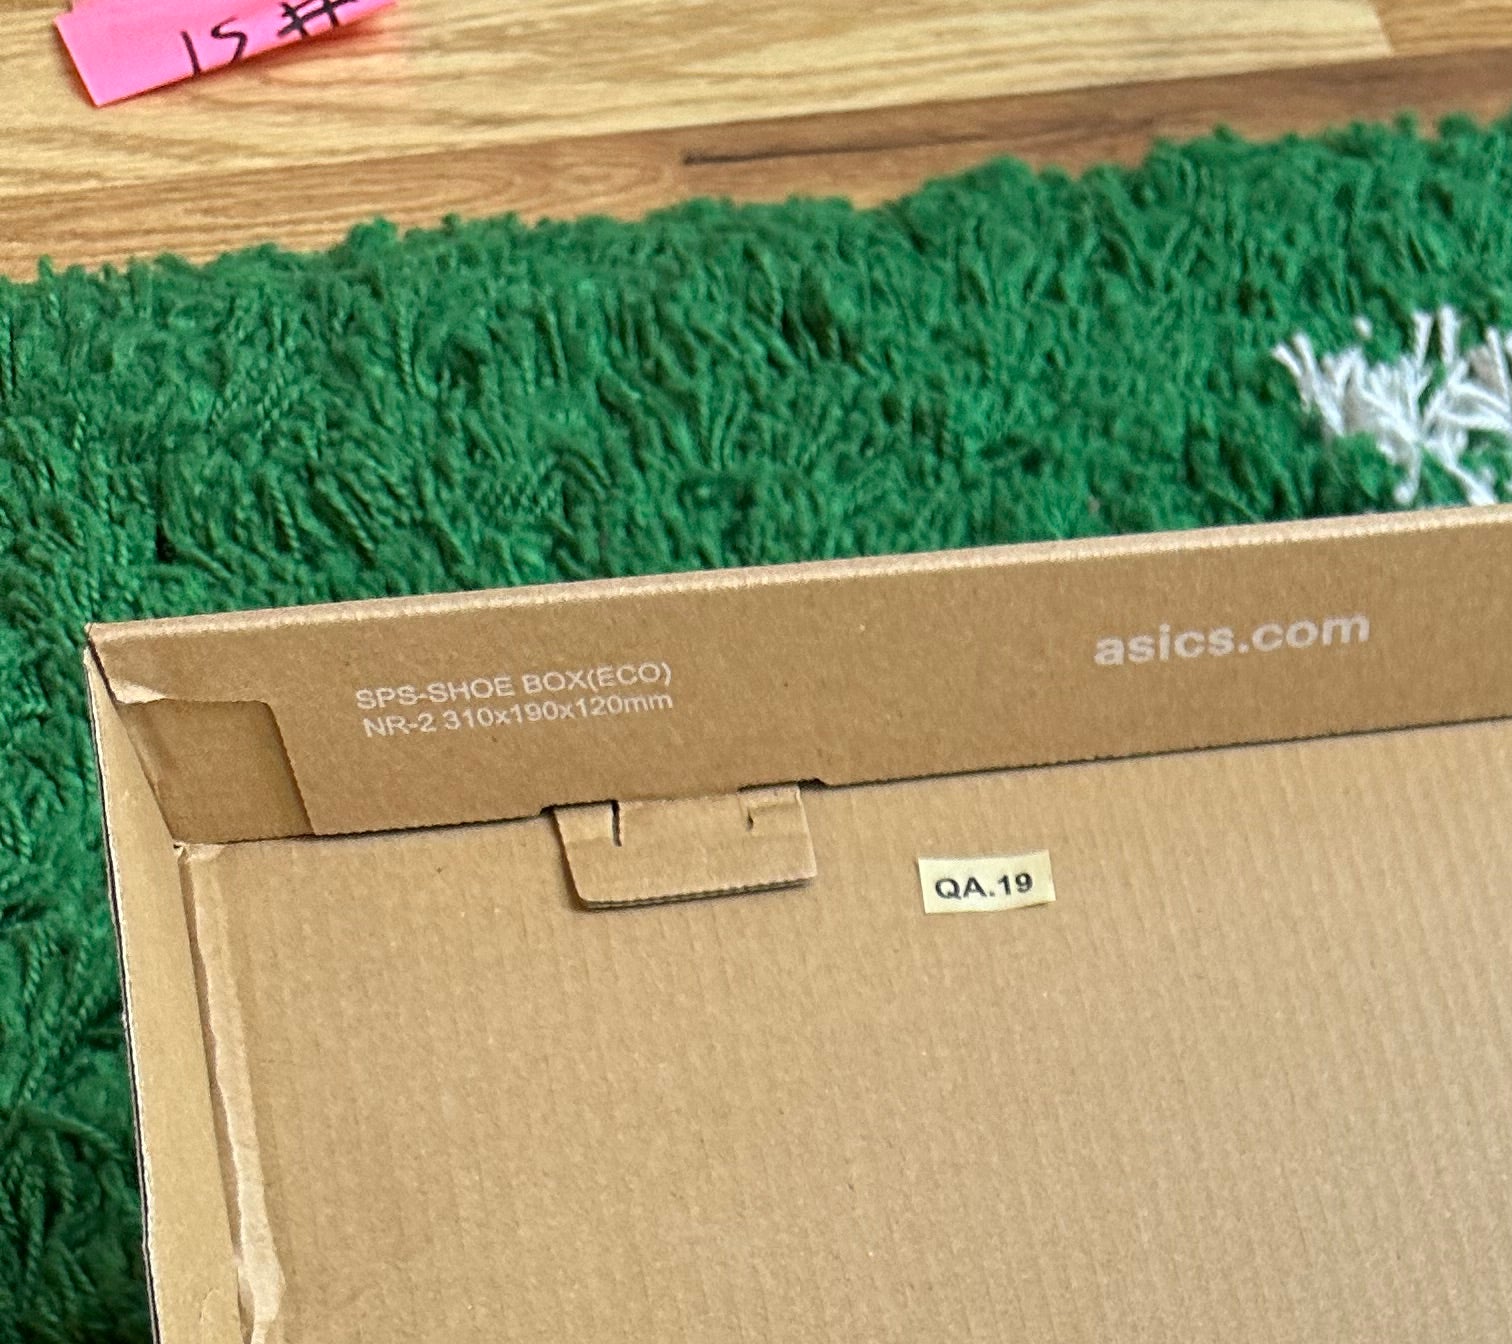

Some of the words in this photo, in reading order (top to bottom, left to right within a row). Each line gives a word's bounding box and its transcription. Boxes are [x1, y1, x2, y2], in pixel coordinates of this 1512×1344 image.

[1094, 612, 1371, 666] asics.com
[355, 676, 515, 709] SPS-SHOE
[521, 661, 672, 695] BOX(ECO)
[363, 712, 437, 738] NR-2
[443, 693, 673, 731] 310x190x120mm
[934, 871, 1034, 901] QA.19
